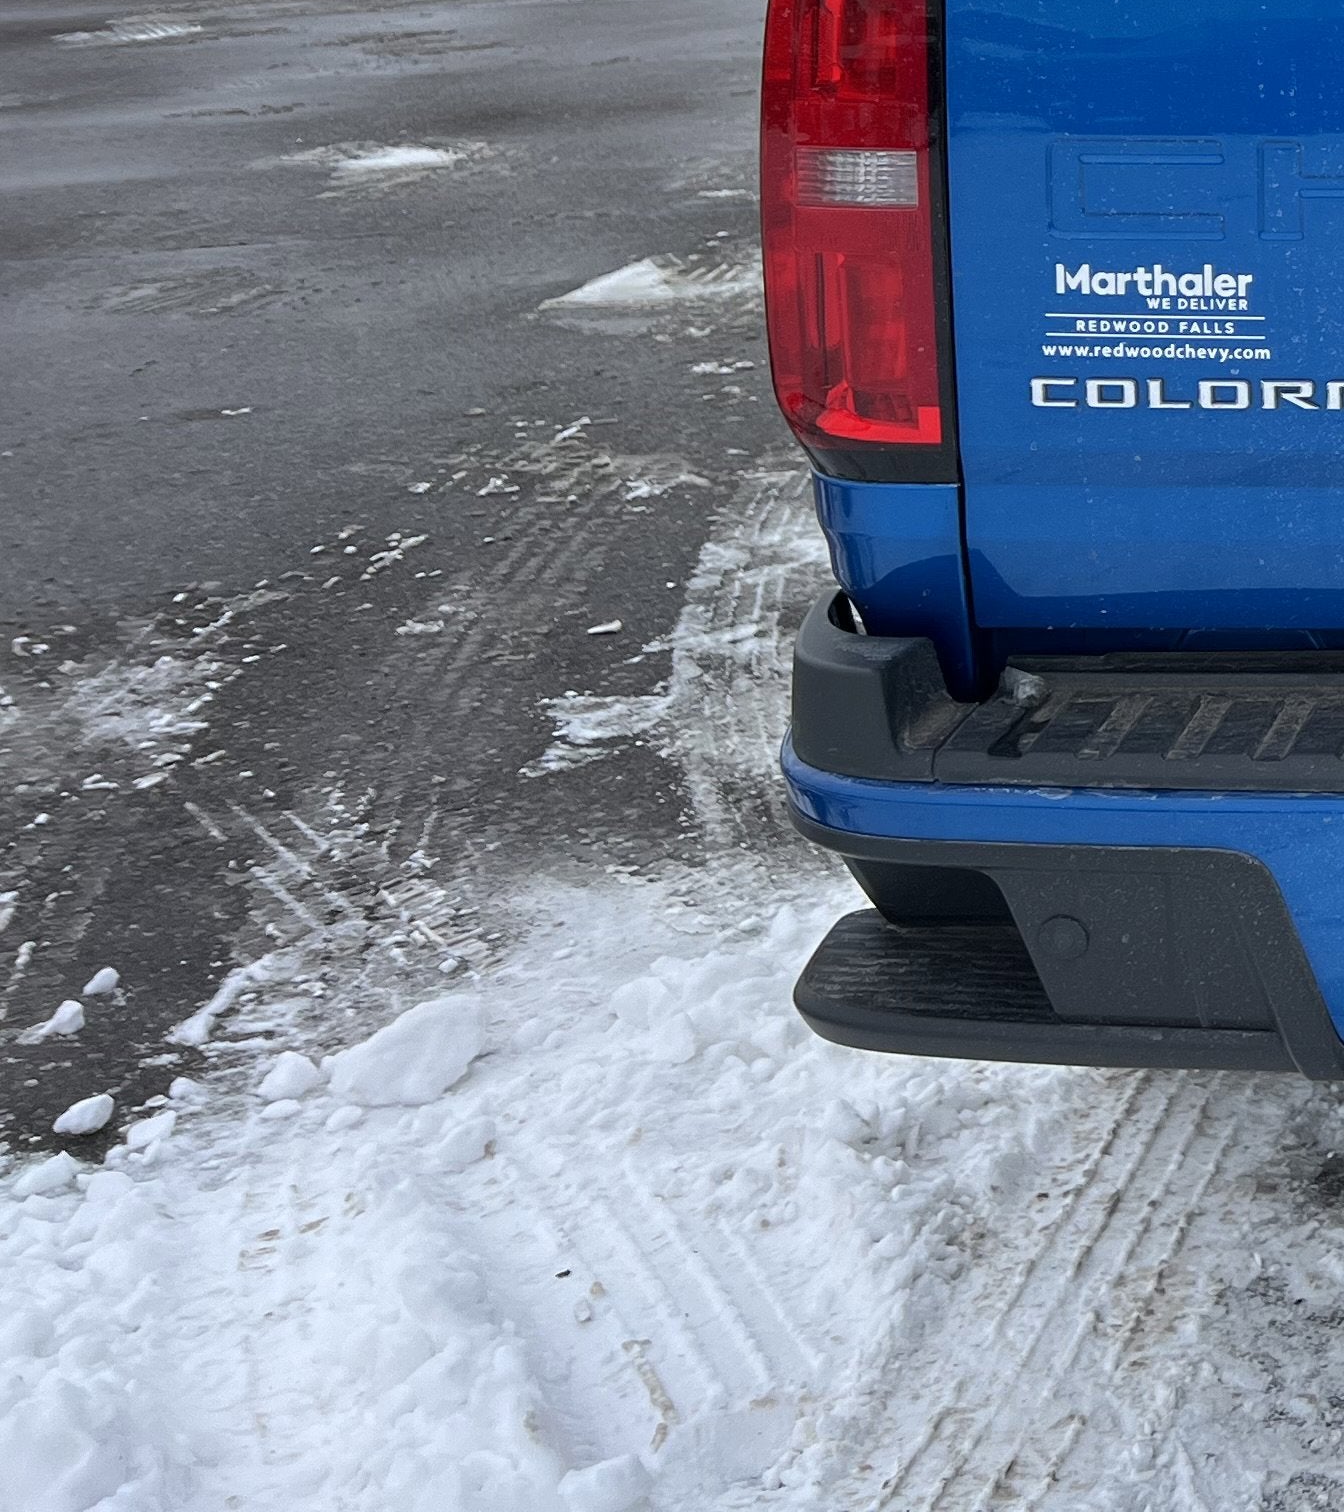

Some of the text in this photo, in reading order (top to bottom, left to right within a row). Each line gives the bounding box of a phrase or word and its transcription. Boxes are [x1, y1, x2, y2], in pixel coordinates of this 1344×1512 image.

[1055, 263, 1253, 297] Marthaler
[1146, 297, 1249, 311] WE DELIVER
[1075, 319, 1236, 335] REDWOOD FALLS
[1041, 341, 1271, 363] www.redwoodchevy.com
